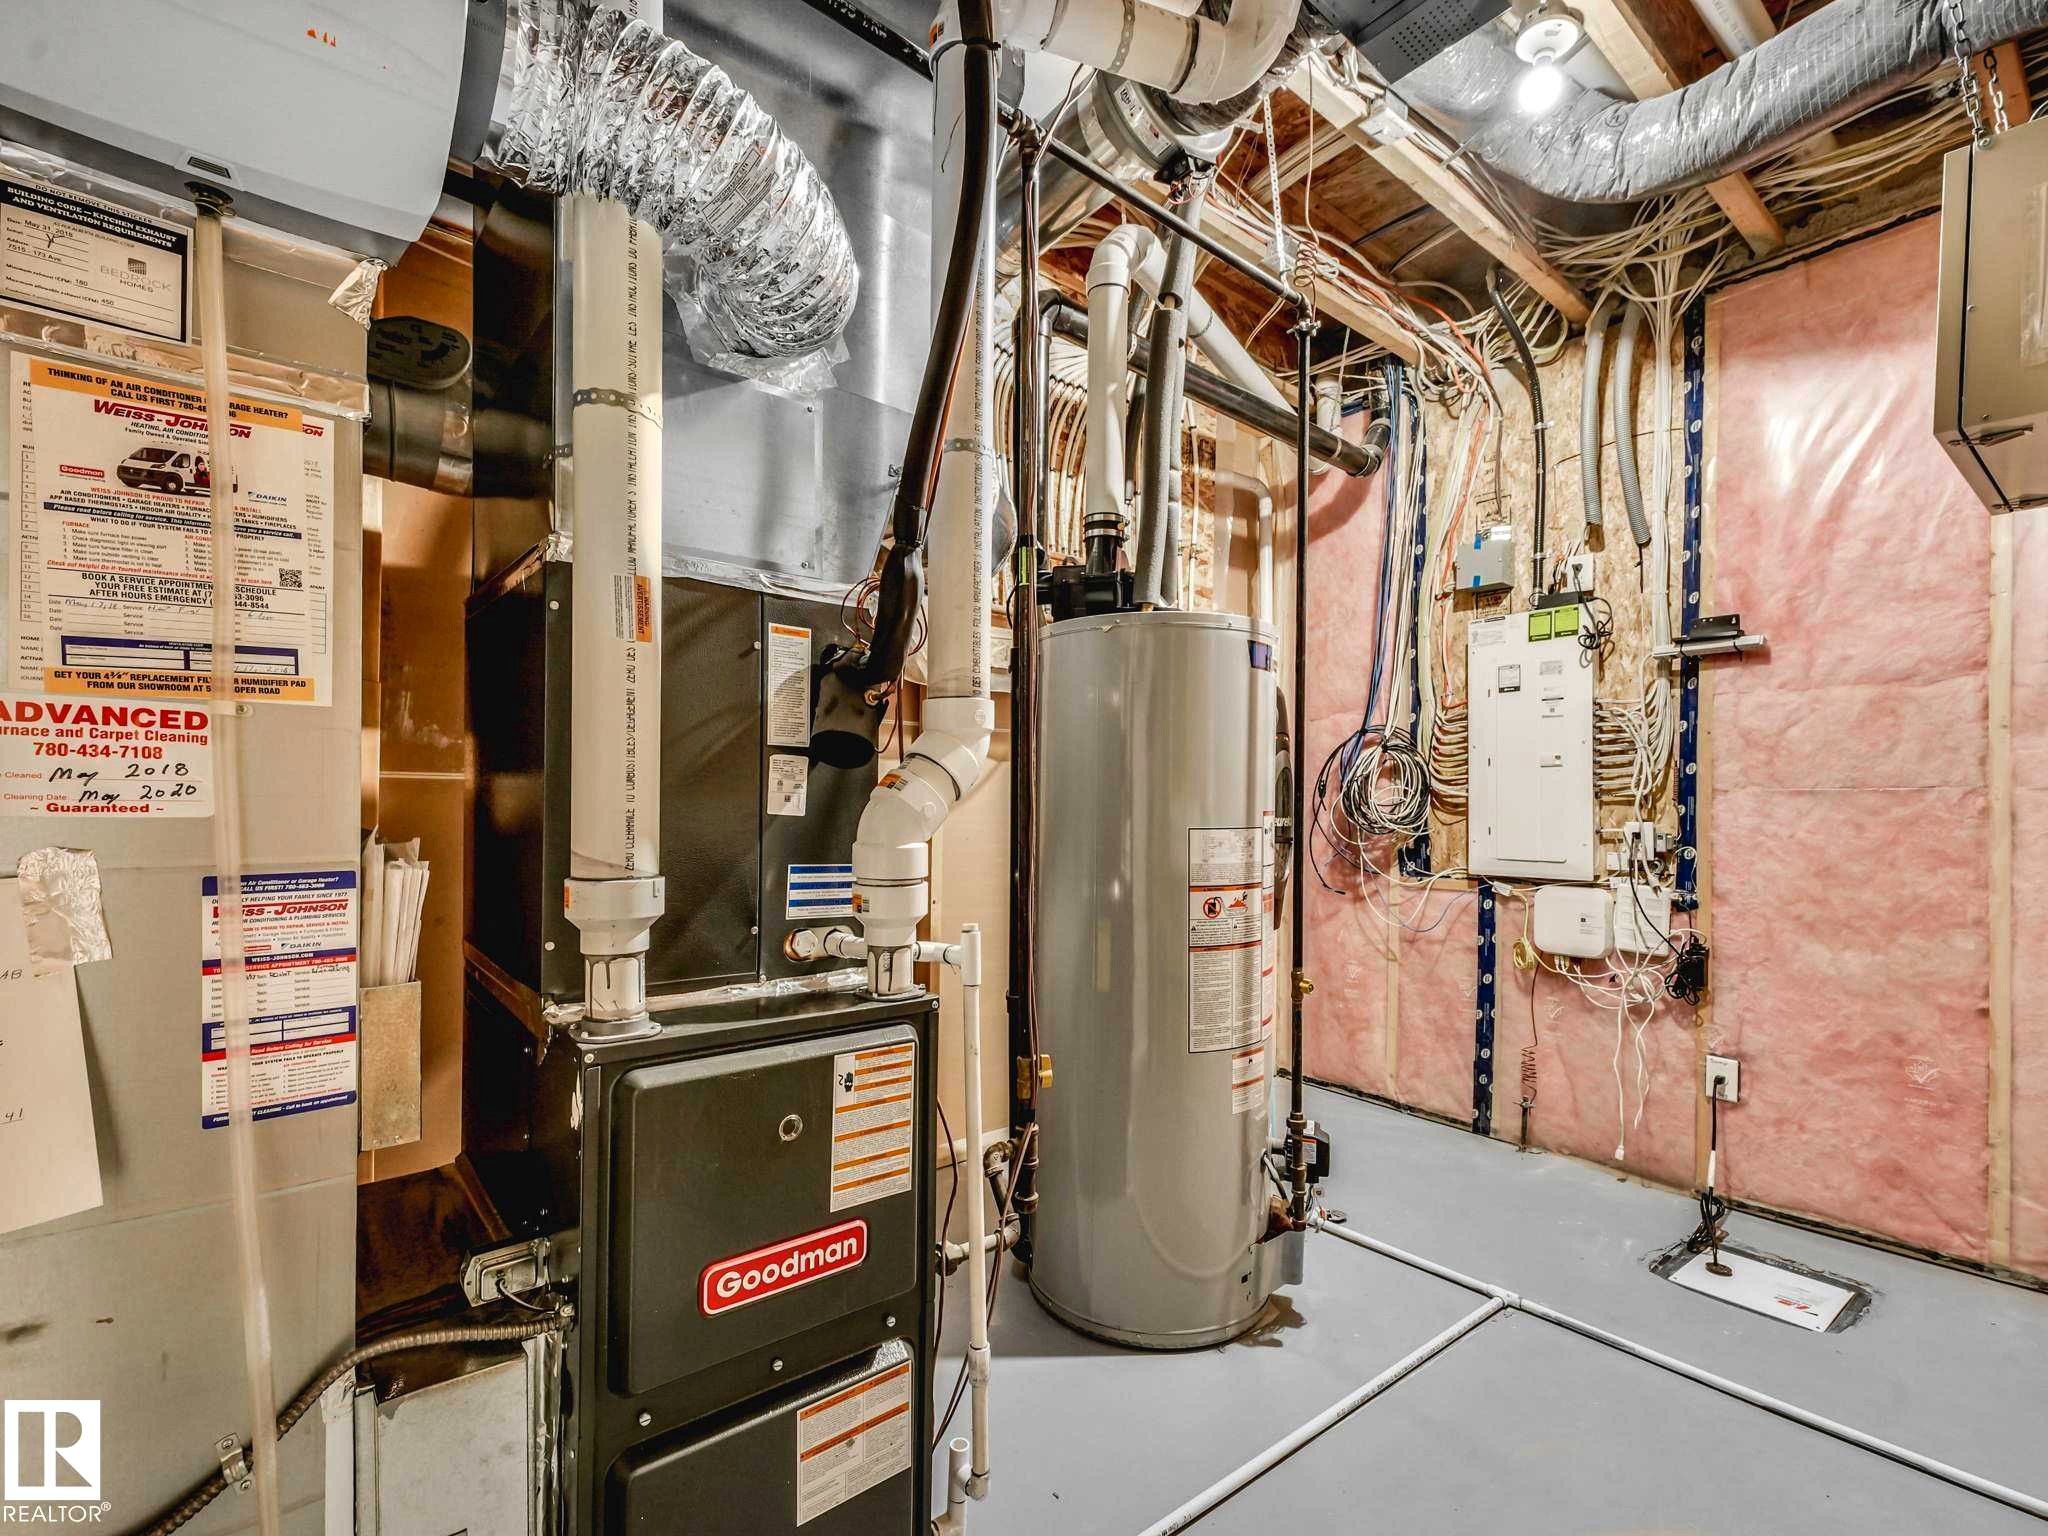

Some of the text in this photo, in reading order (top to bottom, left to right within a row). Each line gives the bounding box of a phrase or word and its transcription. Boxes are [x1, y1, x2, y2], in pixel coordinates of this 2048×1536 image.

[7, 186, 176, 242] BUILDING CODE KITCHEN EXHAUST
[12, 196, 172, 248] AND VENTILATION REQUIREMENTS
[100, 265, 172, 291] BEDROCK
[120, 279, 154, 293] HOMES
[48, 368, 288, 419] THINKING OF AN AIR CONDITIONER HEATER?
[110, 388, 133, 400] CALL
[150, 396, 176, 407] FIRST
[61, 465, 104, 477] Goodman
[256, 494, 287, 502] DAIKIN
[53, 504, 76, 512] Please
[92, 508, 112, 516] before
[114, 511, 134, 520] calling
[73, 491, 121, 502] CONDITIONERS
[153, 501, 180, 510] HEATERS
[252, 514, 288, 523] HUMIDIFIERS
[88, 498, 134, 510] THERMOSTATS
[264, 521, 297, 530] FIREPLACES
[157, 524, 181, 532] SYSTEM
[82, 573, 107, 581] BOOK
[118, 576, 156, 585] SERVICE
[235, 586, 277, 596] SCHEDULE
[95, 581, 121, 590] YOUR
[123, 584, 145, 592] FREE
[150, 586, 189, 596] ESTIMATE
[89, 589, 207, 605] AFTER HOURS EMERGENCY
[76, 672, 101, 680] YOUR
[130, 673, 194, 683] REPLACEMENT
[87, 681, 114, 689] FROM
[138, 682, 191, 691] SHOWROOM
[55, 725, 83, 738] and
[89, 728, 139, 742] Carpet
[145, 730, 208, 745] Cleaning
[33, 742, 163, 759] 780-434-7108
[4, 771, 42, 779] Cleaned
[49, 763, 189, 787] May 2018
[4, 793, 43, 801] Cleaning
[79, 783, 197, 805] May 2020
[46, 803, 150, 814] Guaranteed
[716, 1236, 857, 1298] Goodman
